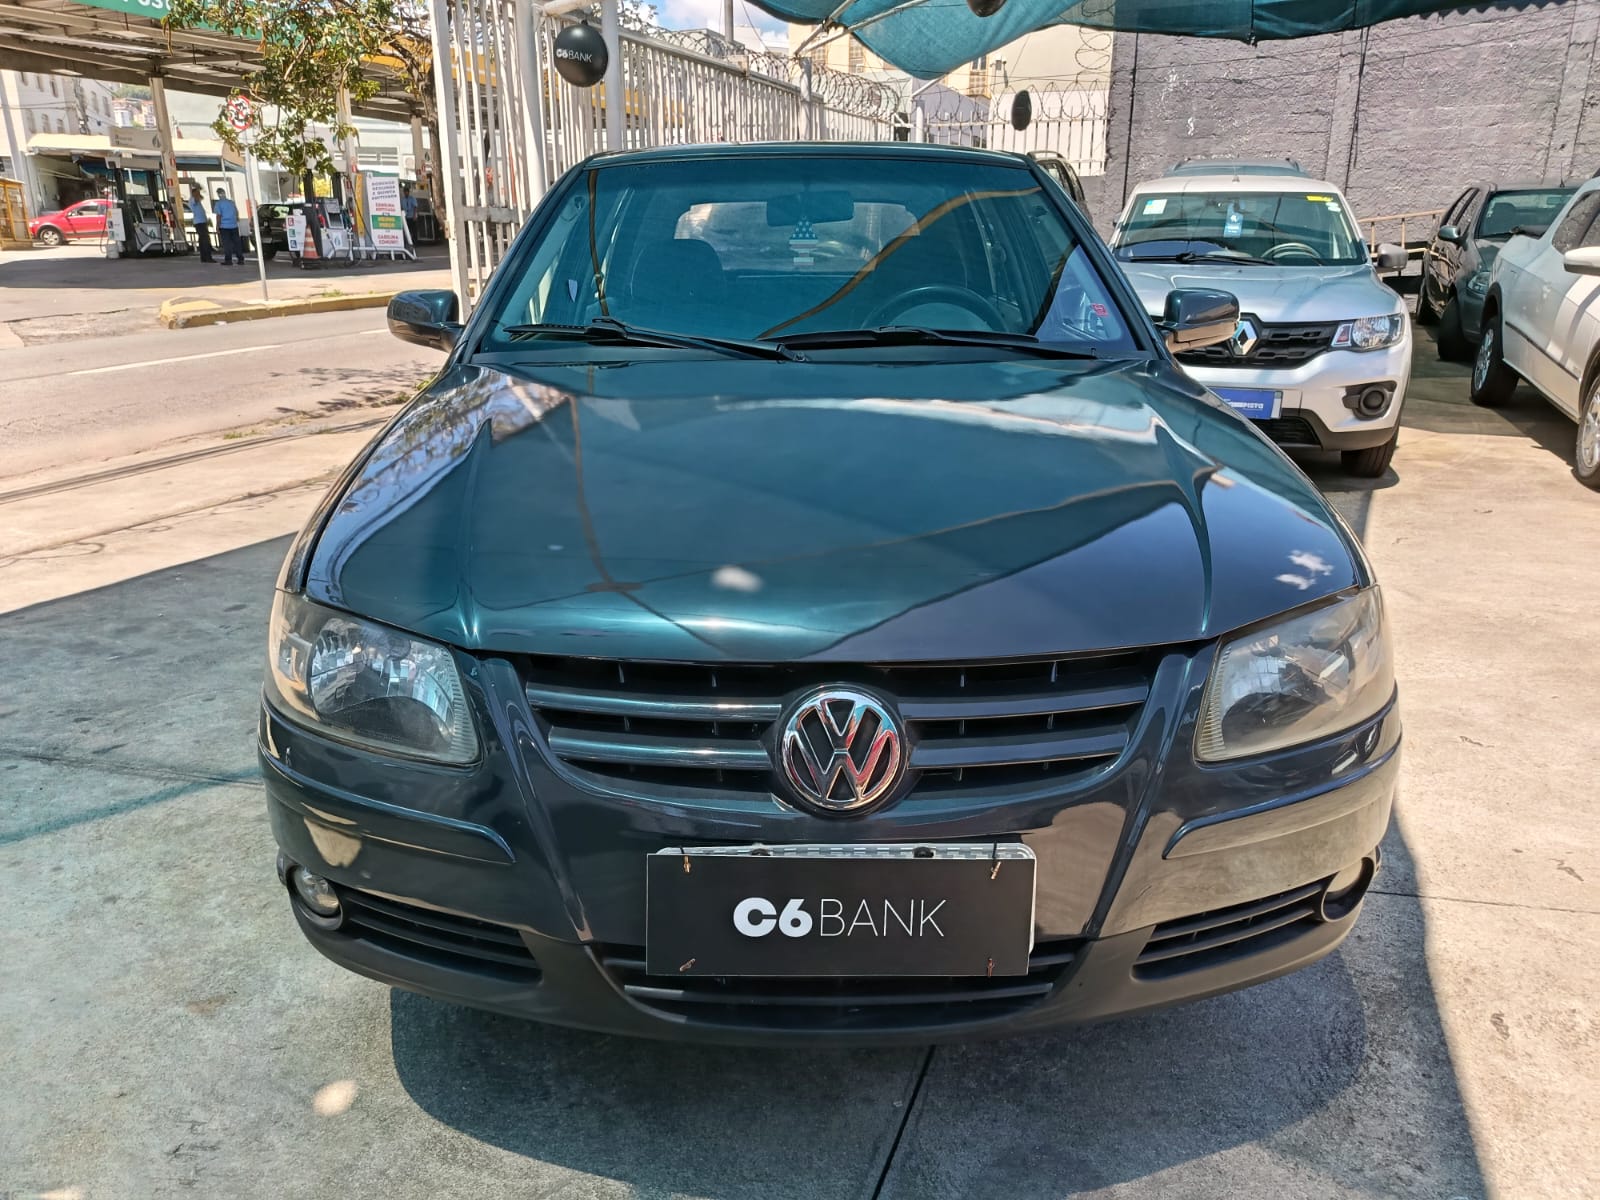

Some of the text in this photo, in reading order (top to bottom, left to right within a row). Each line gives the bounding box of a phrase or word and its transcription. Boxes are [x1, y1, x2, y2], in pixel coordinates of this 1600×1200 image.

[568, 49, 593, 63] BANK
[733, 896, 947, 938] C6 BANK
